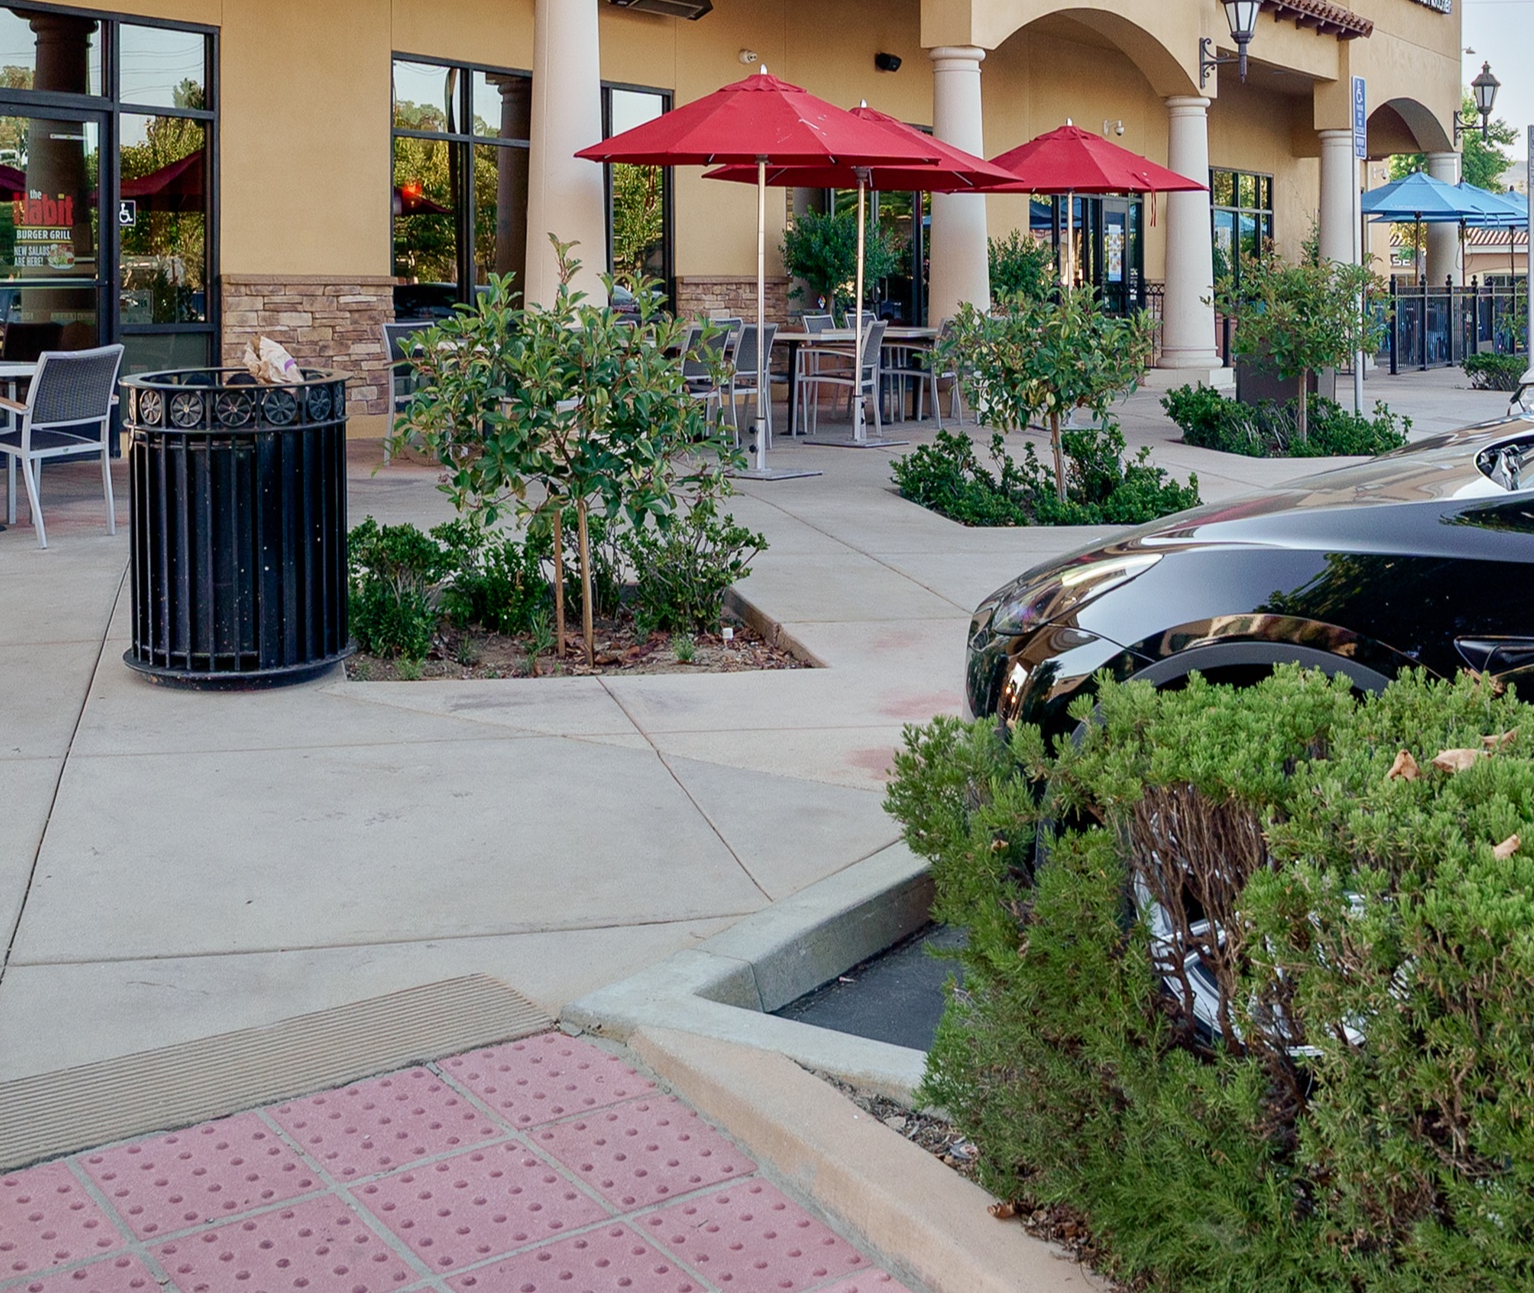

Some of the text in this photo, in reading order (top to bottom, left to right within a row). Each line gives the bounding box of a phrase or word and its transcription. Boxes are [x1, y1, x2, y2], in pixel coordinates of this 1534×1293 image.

[29, 189, 42, 200] the
[13, 192, 73, 226] Habit
[16, 229, 71, 240] BURGER GRILL
[14, 245, 50, 256] NEW SALADS
[14, 256, 25, 267] ARE
